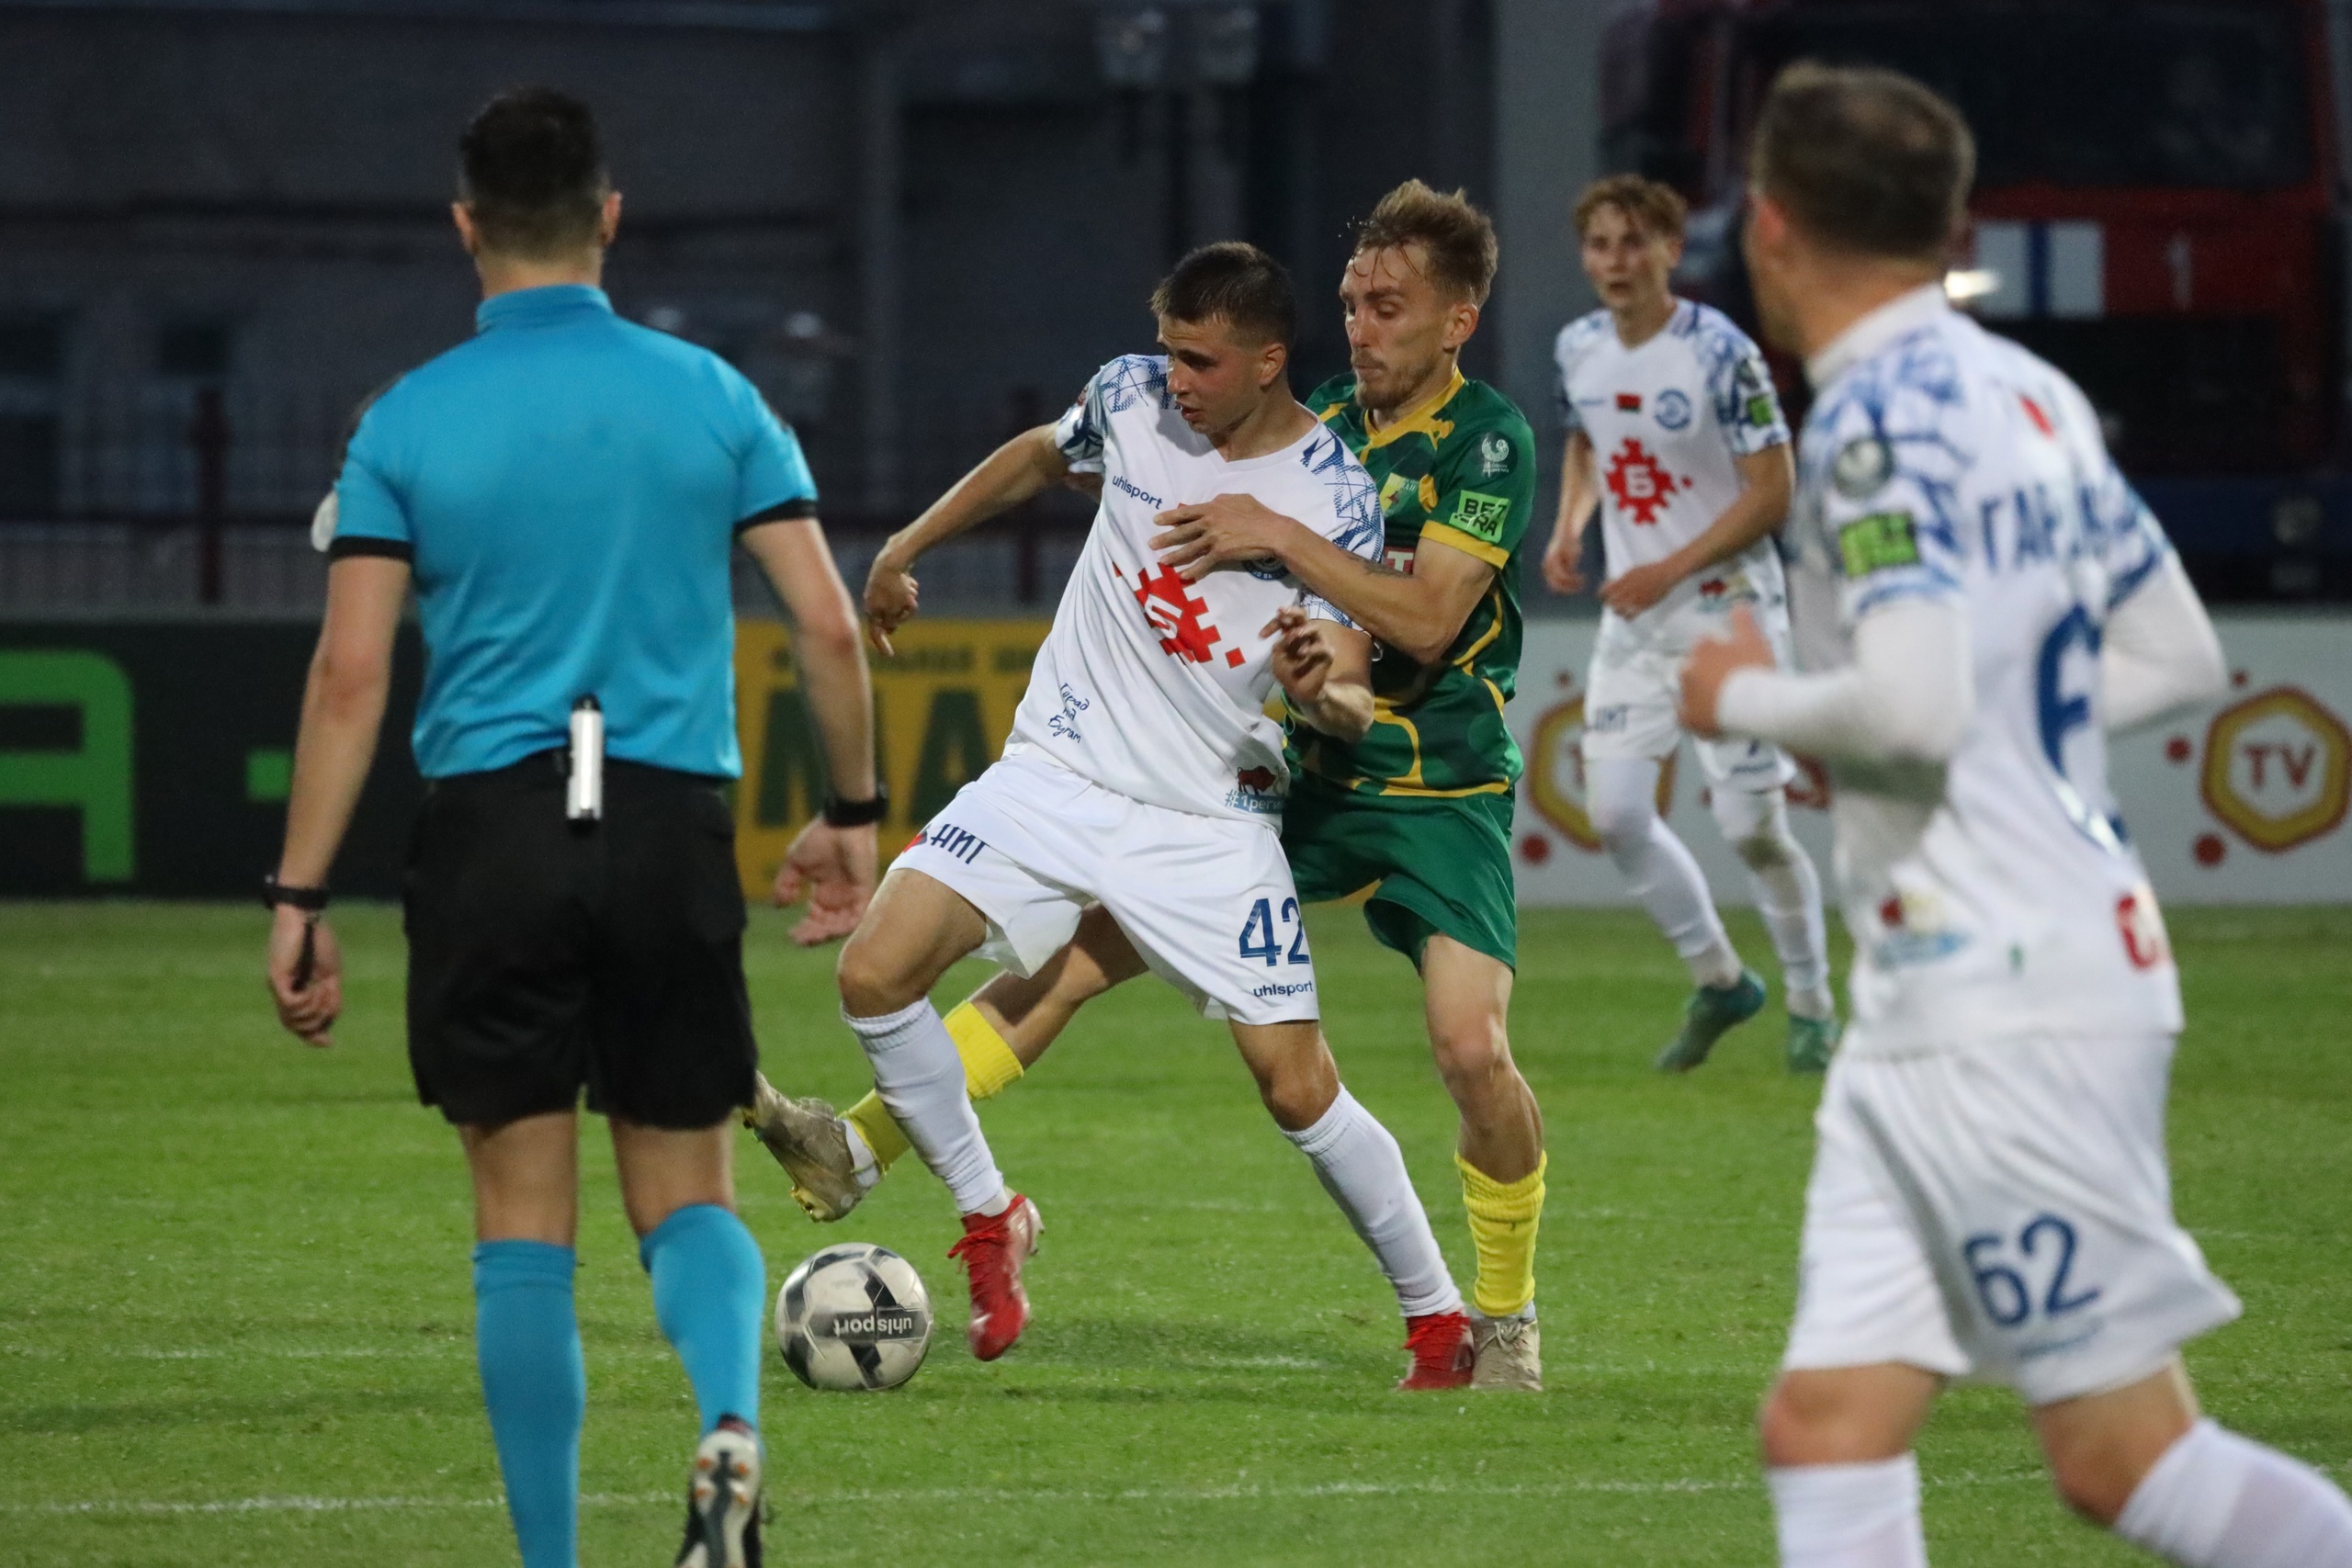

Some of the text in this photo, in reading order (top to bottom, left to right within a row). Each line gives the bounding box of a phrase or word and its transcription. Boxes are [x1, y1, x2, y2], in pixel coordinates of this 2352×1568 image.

[1113, 475, 1162, 510] uhlsport
[2244, 742, 2317, 790] TV
[1238, 897, 1310, 967] 42
[1253, 980, 1314, 998] uhlsport
[1964, 1212, 2104, 1327] 62
[834, 1315, 912, 1337] uhlsport
